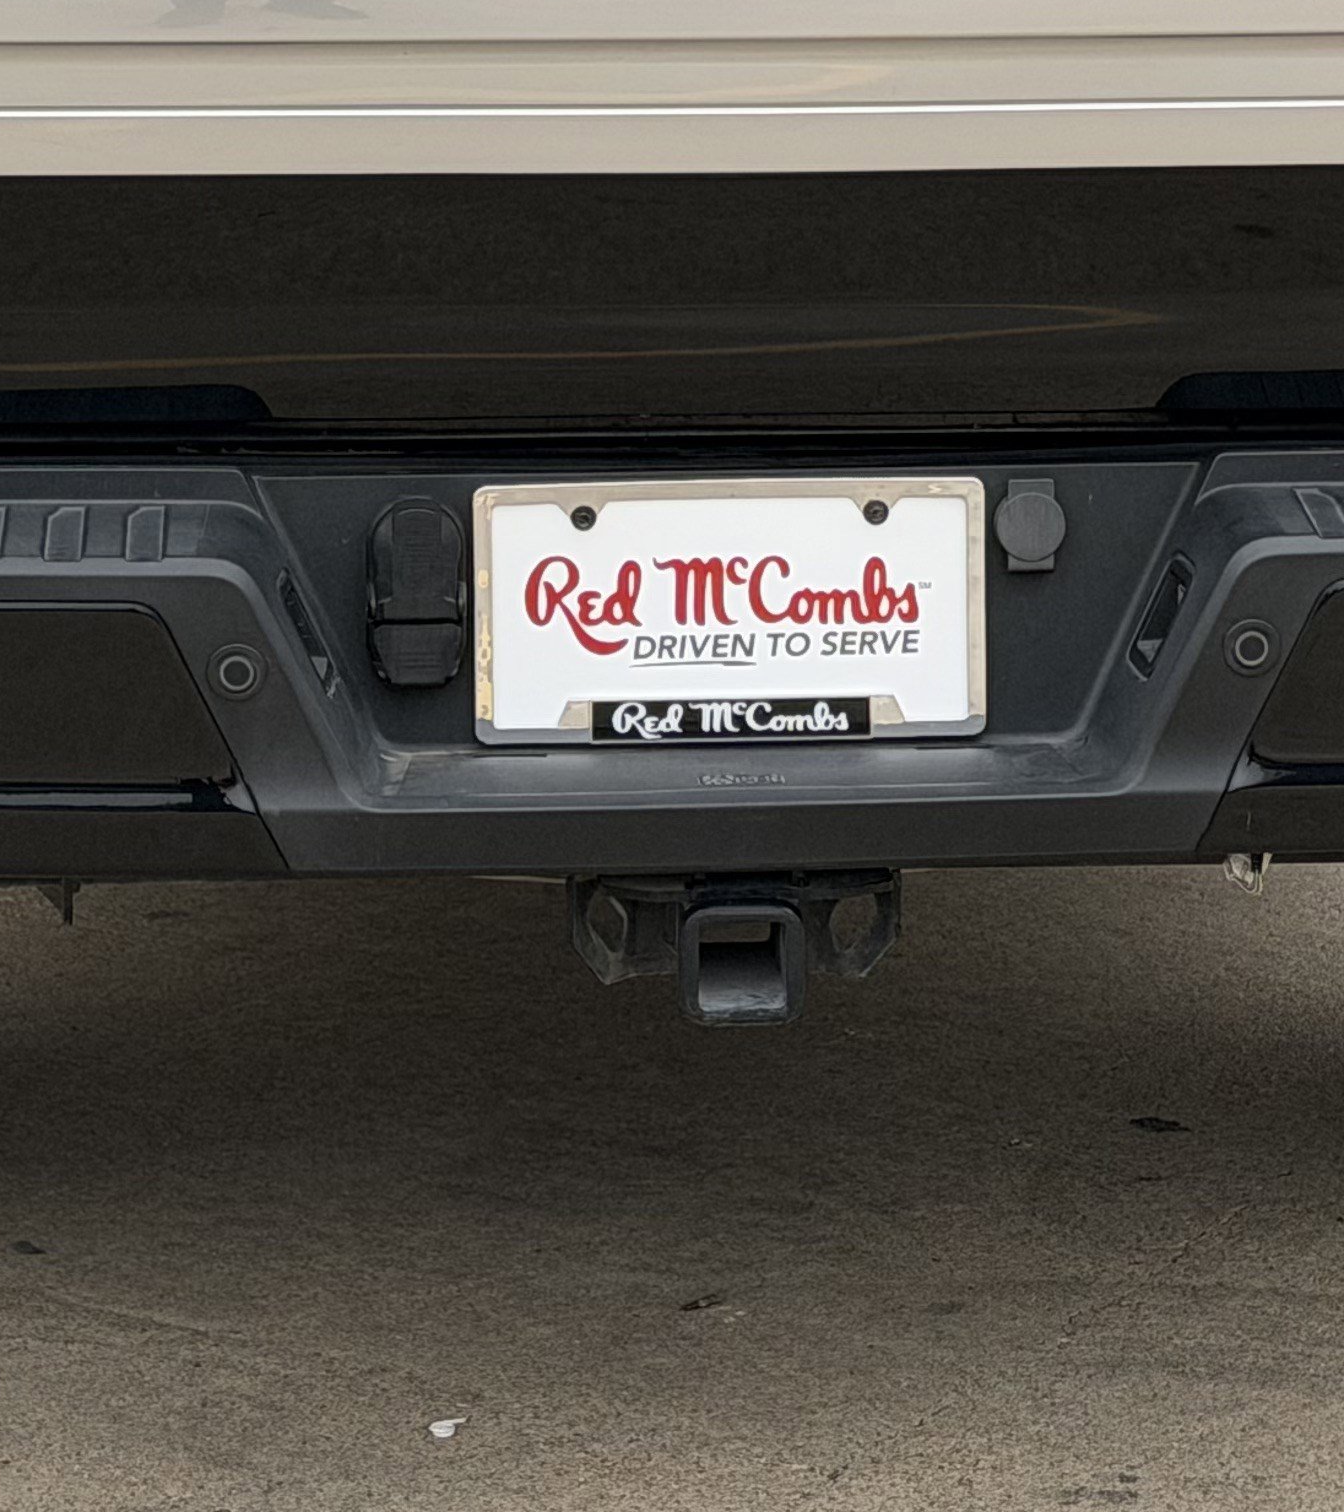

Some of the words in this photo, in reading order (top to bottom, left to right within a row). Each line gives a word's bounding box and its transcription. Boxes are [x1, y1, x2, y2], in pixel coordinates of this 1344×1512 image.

[525, 555, 642, 656] Red
[653, 555, 919, 625] McCombs
[633, 632, 756, 661] DRIVEN
[767, 632, 812, 657] TO
[821, 630, 921, 656] SERVE
[612, 701, 684, 741] Red
[689, 701, 850, 735] McCombs
